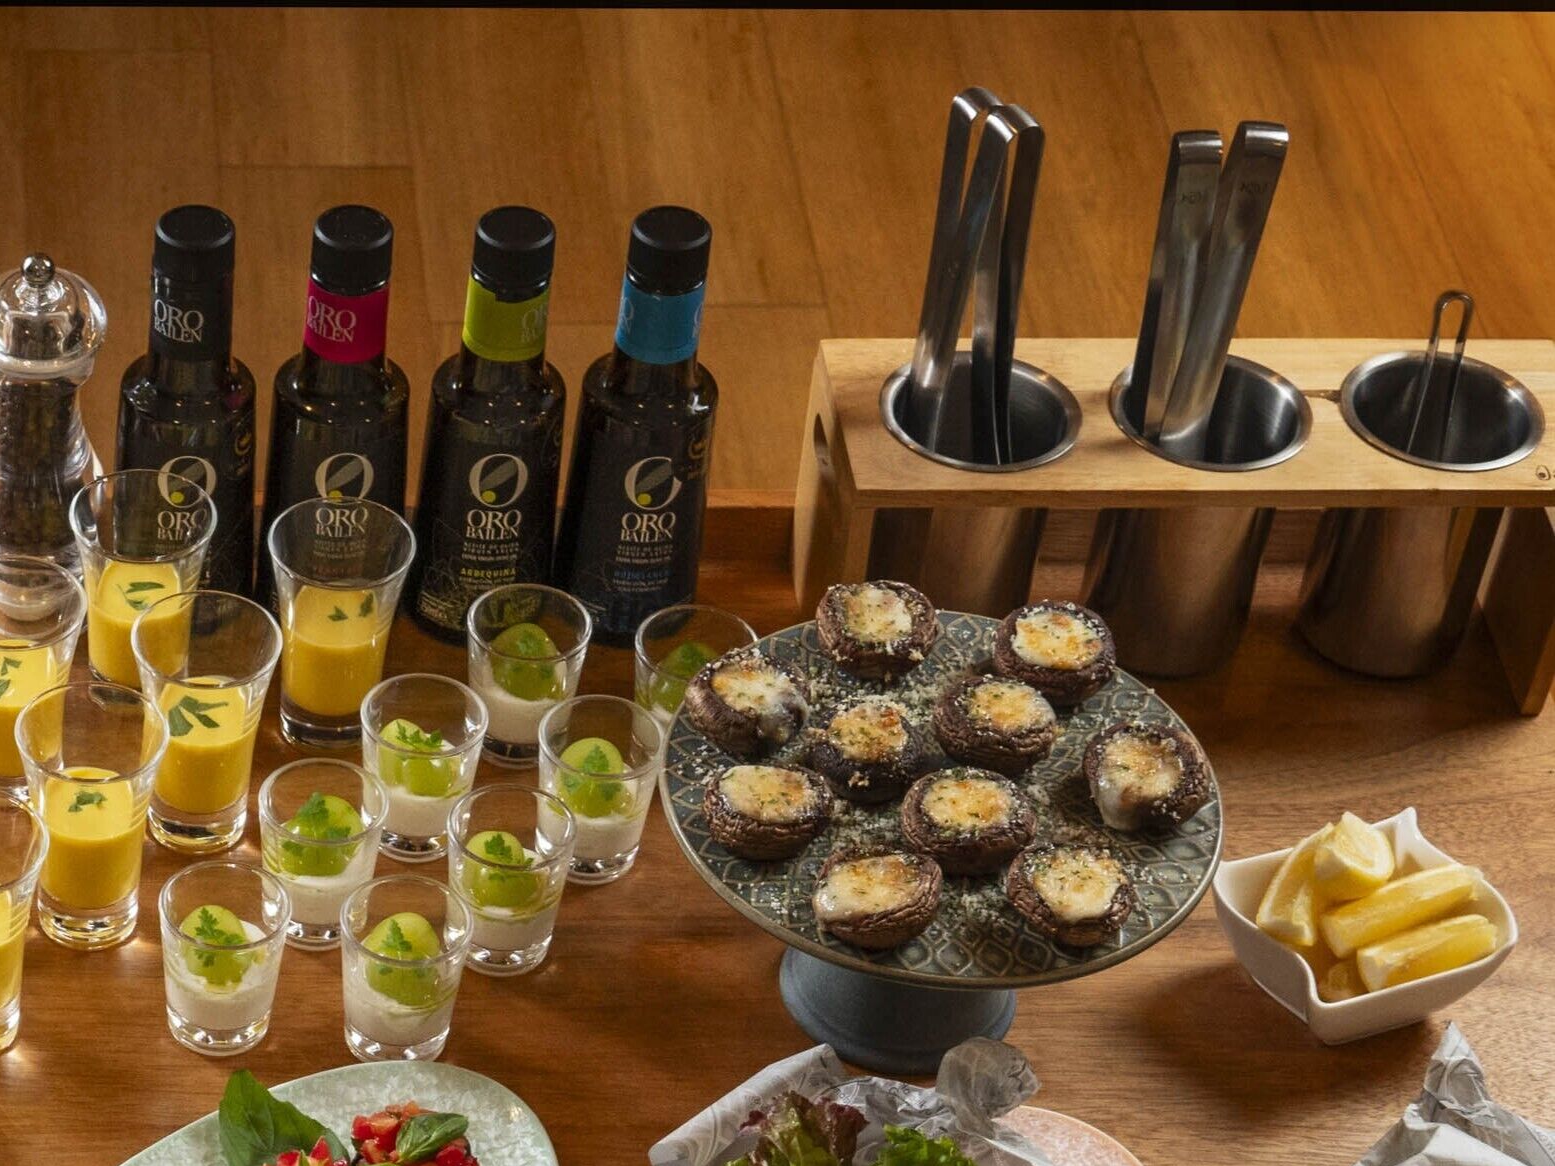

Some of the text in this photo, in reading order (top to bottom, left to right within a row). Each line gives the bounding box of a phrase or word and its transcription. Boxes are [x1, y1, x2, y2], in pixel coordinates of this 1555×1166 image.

[154, 298, 204, 332] ORO
[308, 295, 357, 331] ORO
[315, 506, 369, 529] ORO
[467, 509, 522, 532] ORO
[621, 512, 676, 534] ORO
[465, 525, 520, 540] BAILEN
